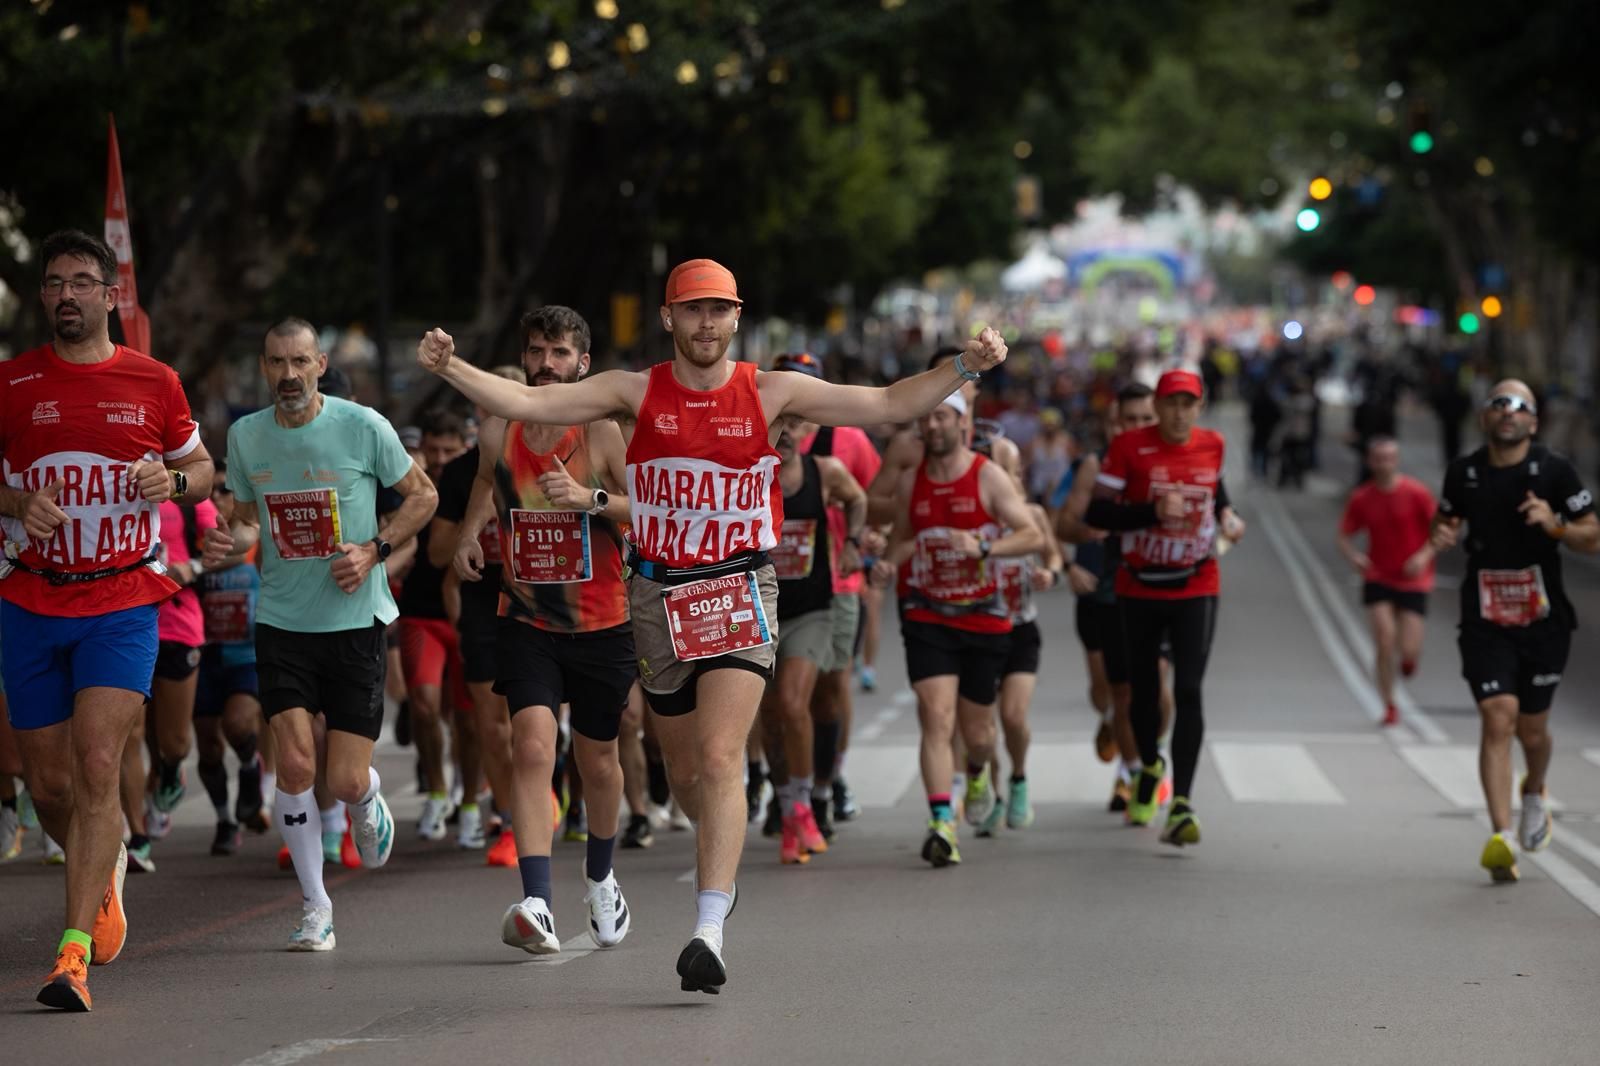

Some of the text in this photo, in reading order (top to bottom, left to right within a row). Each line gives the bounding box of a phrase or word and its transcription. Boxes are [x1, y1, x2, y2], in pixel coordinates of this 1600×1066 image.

[685, 400, 709, 408] luanvi
[106, 413, 137, 425] MÁLAGA
[717, 427, 744, 437] MÁLAGA
[635, 465, 765, 511] MARATÓN
[281, 491, 325, 504] GENERALI
[284, 507, 318, 521] 3378
[528, 512, 576, 524] GENERALI
[527, 528, 564, 543] 5110
[686, 576, 744, 596] GENERALI
[689, 594, 734, 617] 5028
[702, 613, 724, 622] HARRY
